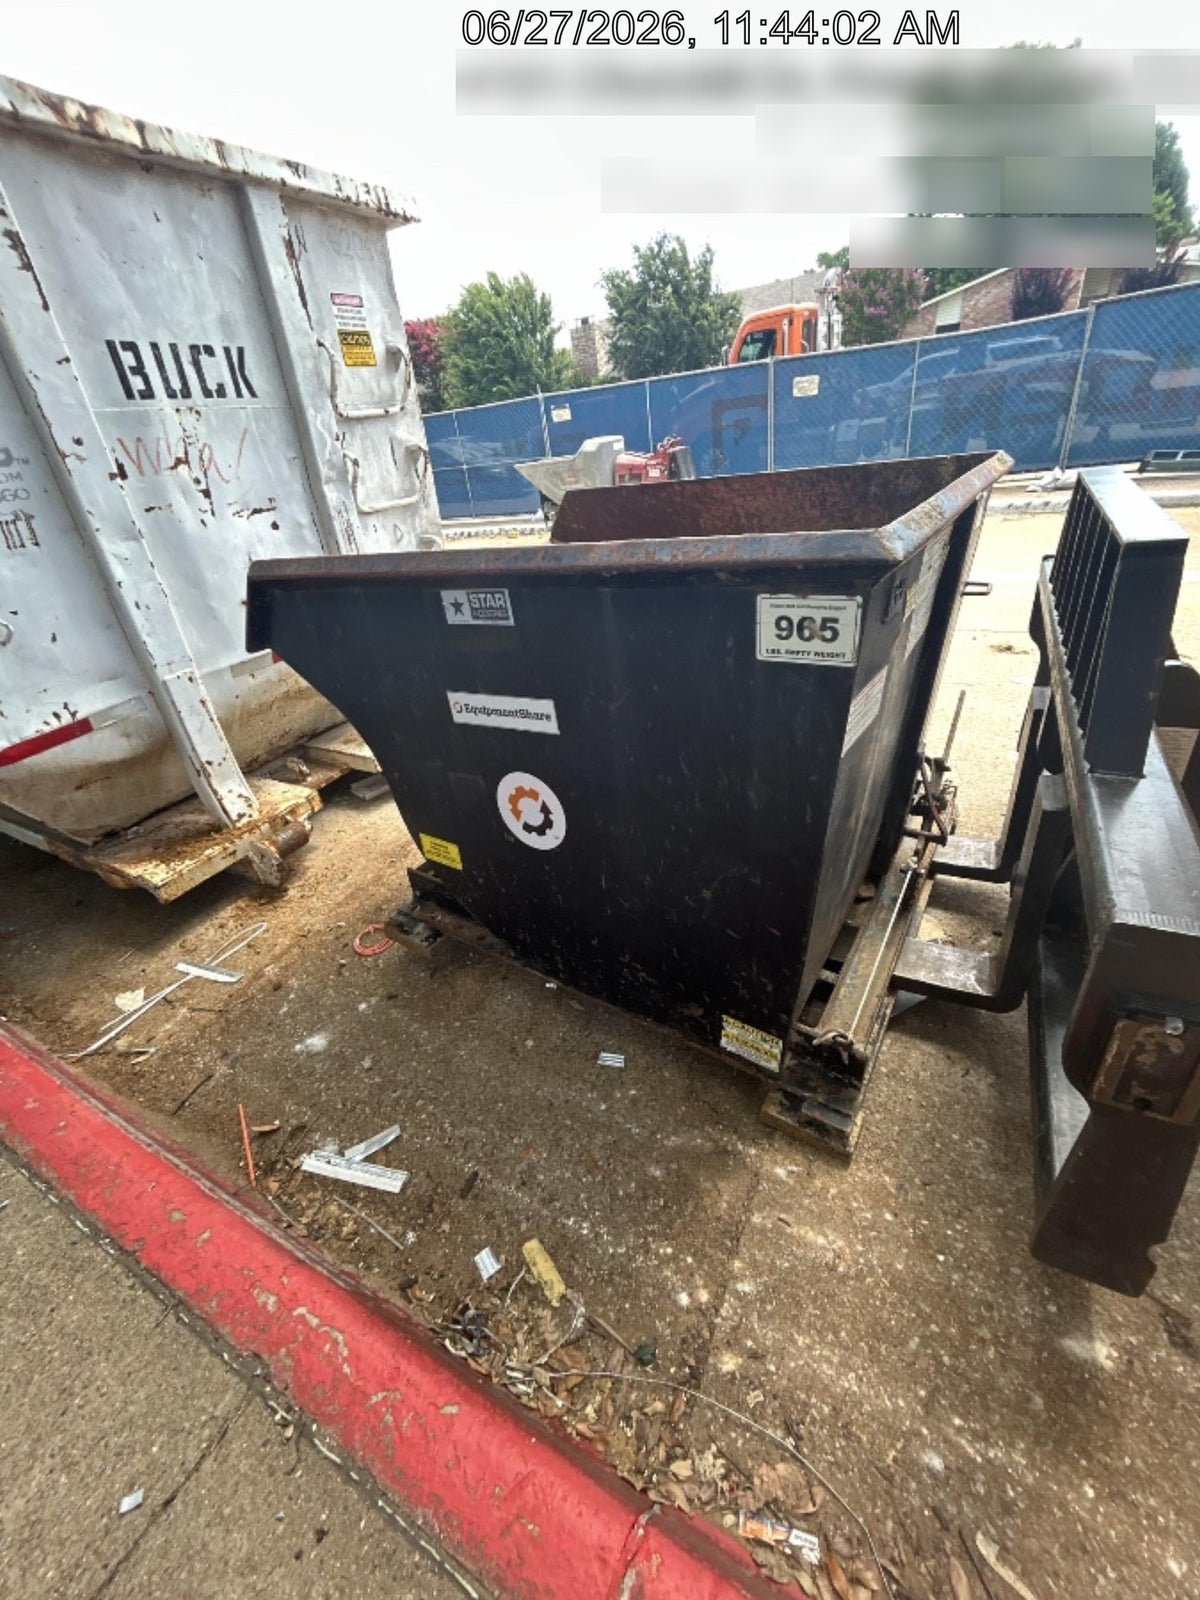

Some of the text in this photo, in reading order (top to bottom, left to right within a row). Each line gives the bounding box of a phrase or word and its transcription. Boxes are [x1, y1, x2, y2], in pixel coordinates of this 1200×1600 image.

[105, 339, 259, 400] BUCK
[469, 593, 506, 608] STAR
[774, 615, 840, 643] 965
[785, 648, 812, 657] EMPTY
[814, 651, 847, 660] WEIGHT
[463, 703, 553, 722] EquipmentShare
